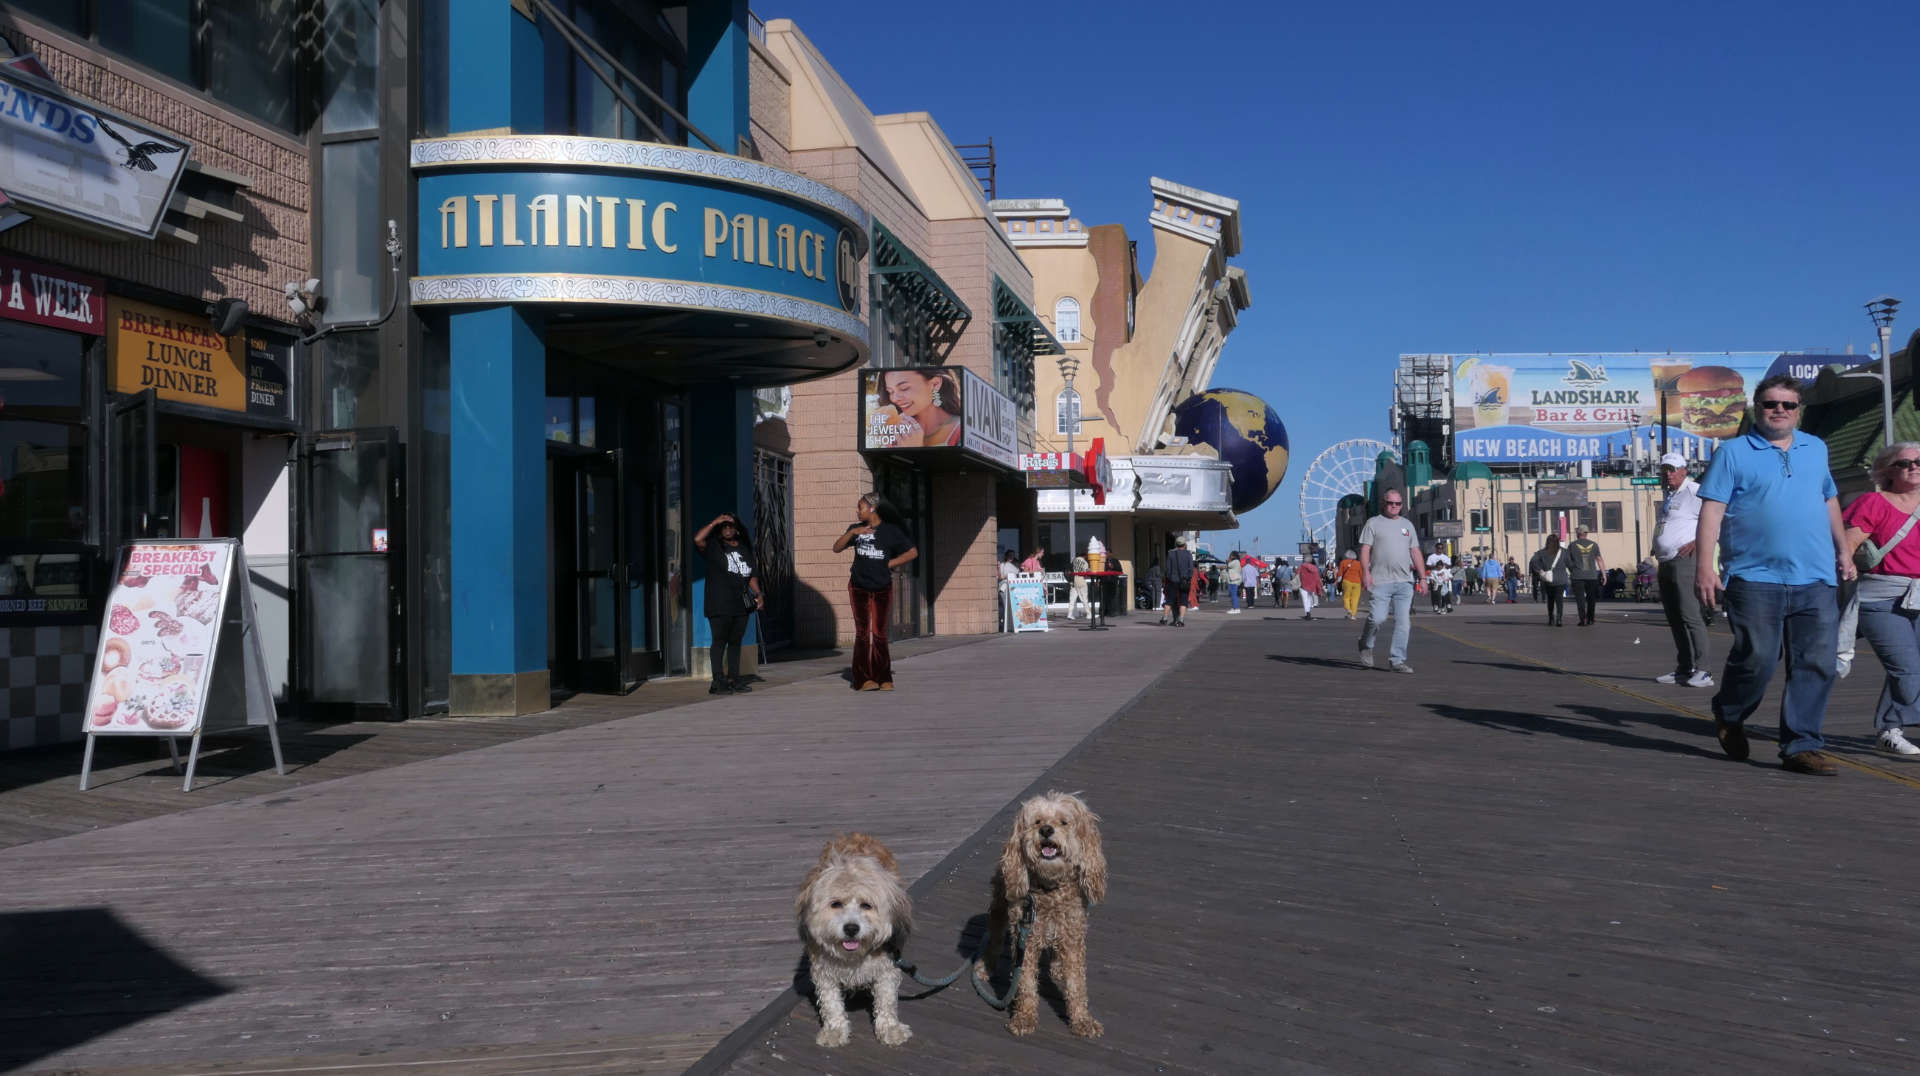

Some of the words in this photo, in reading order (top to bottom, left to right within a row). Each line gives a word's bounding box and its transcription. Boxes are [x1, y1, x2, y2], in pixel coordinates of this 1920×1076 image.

[438, 194, 678, 254] ATLANTIC
[704, 207, 826, 281] PALACE
[8, 267, 25, 310] A
[31, 273, 93, 324] WEEK
[120, 309, 232, 353] BREAKFAST
[146, 340, 212, 372] LUNCH
[1789, 363, 1824, 379] LOCA
[141, 364, 218, 397] DINNER
[250, 391, 275, 407] DINER
[1531, 390, 1639, 405] LANDSHARK
[870, 414, 887, 424] THE
[1536, 408, 1567, 421] Bar
[1573, 408, 1587, 421] &
[1593, 408, 1638, 421] Grill
[870, 424, 911, 435] JEWELRY
[868, 435, 896, 445] SHOP
[1463, 439, 1500, 457] NEW
[1506, 438, 1561, 456] BEACH
[1567, 438, 1600, 456] BAR
[131, 551, 216, 564] BREAKFAST
[143, 563, 201, 576] SPECIAL
